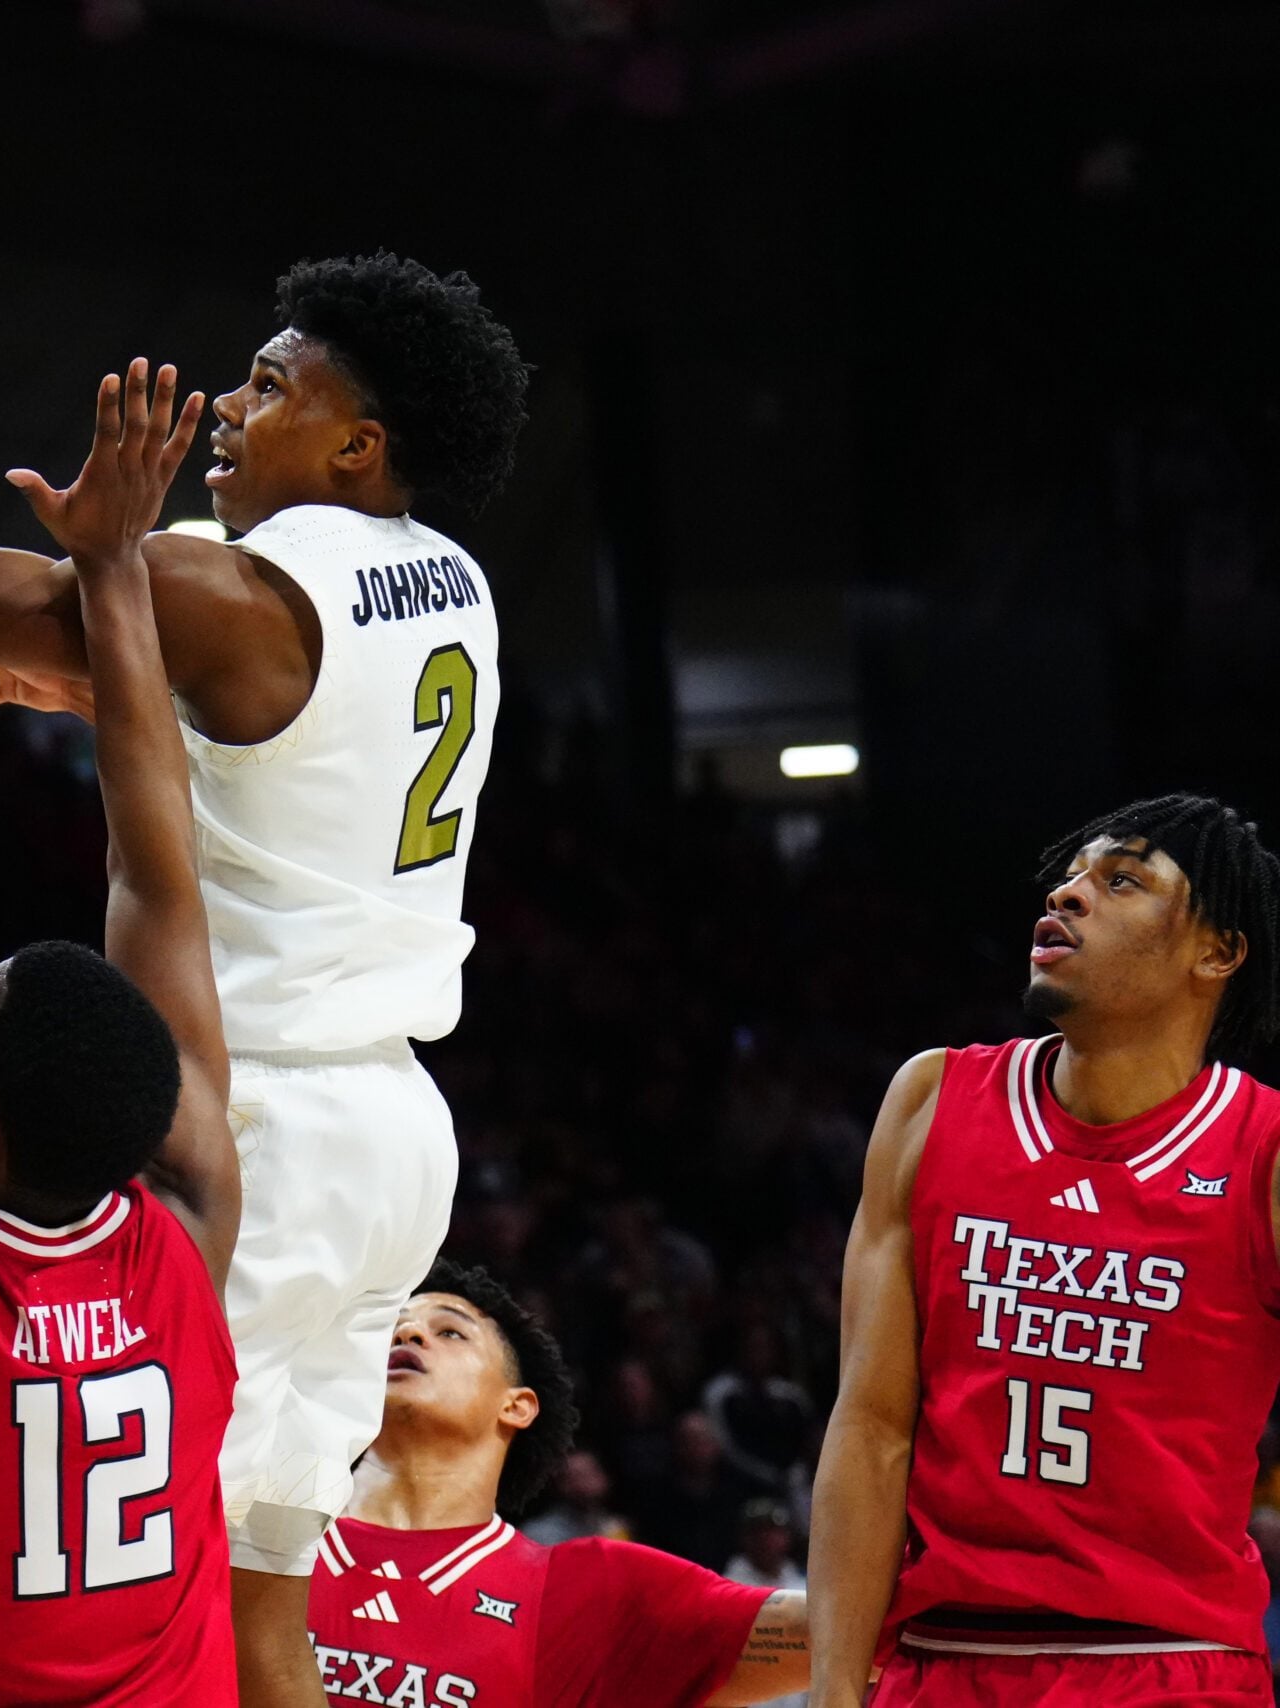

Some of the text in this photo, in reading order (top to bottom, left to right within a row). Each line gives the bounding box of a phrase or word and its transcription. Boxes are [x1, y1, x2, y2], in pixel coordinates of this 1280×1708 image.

[352, 555, 481, 627] JOHNSON
[393, 641, 478, 876] 2
[1178, 1168, 1230, 1198] XII
[952, 1213, 1187, 1313] TEXAS
[966, 1281, 1150, 1372] TECH
[1000, 1377, 1093, 1487] 15
[11, 1359, 176, 1601] 12
[472, 1589, 521, 1627] XII
[307, 1631, 477, 1708] EXAS
